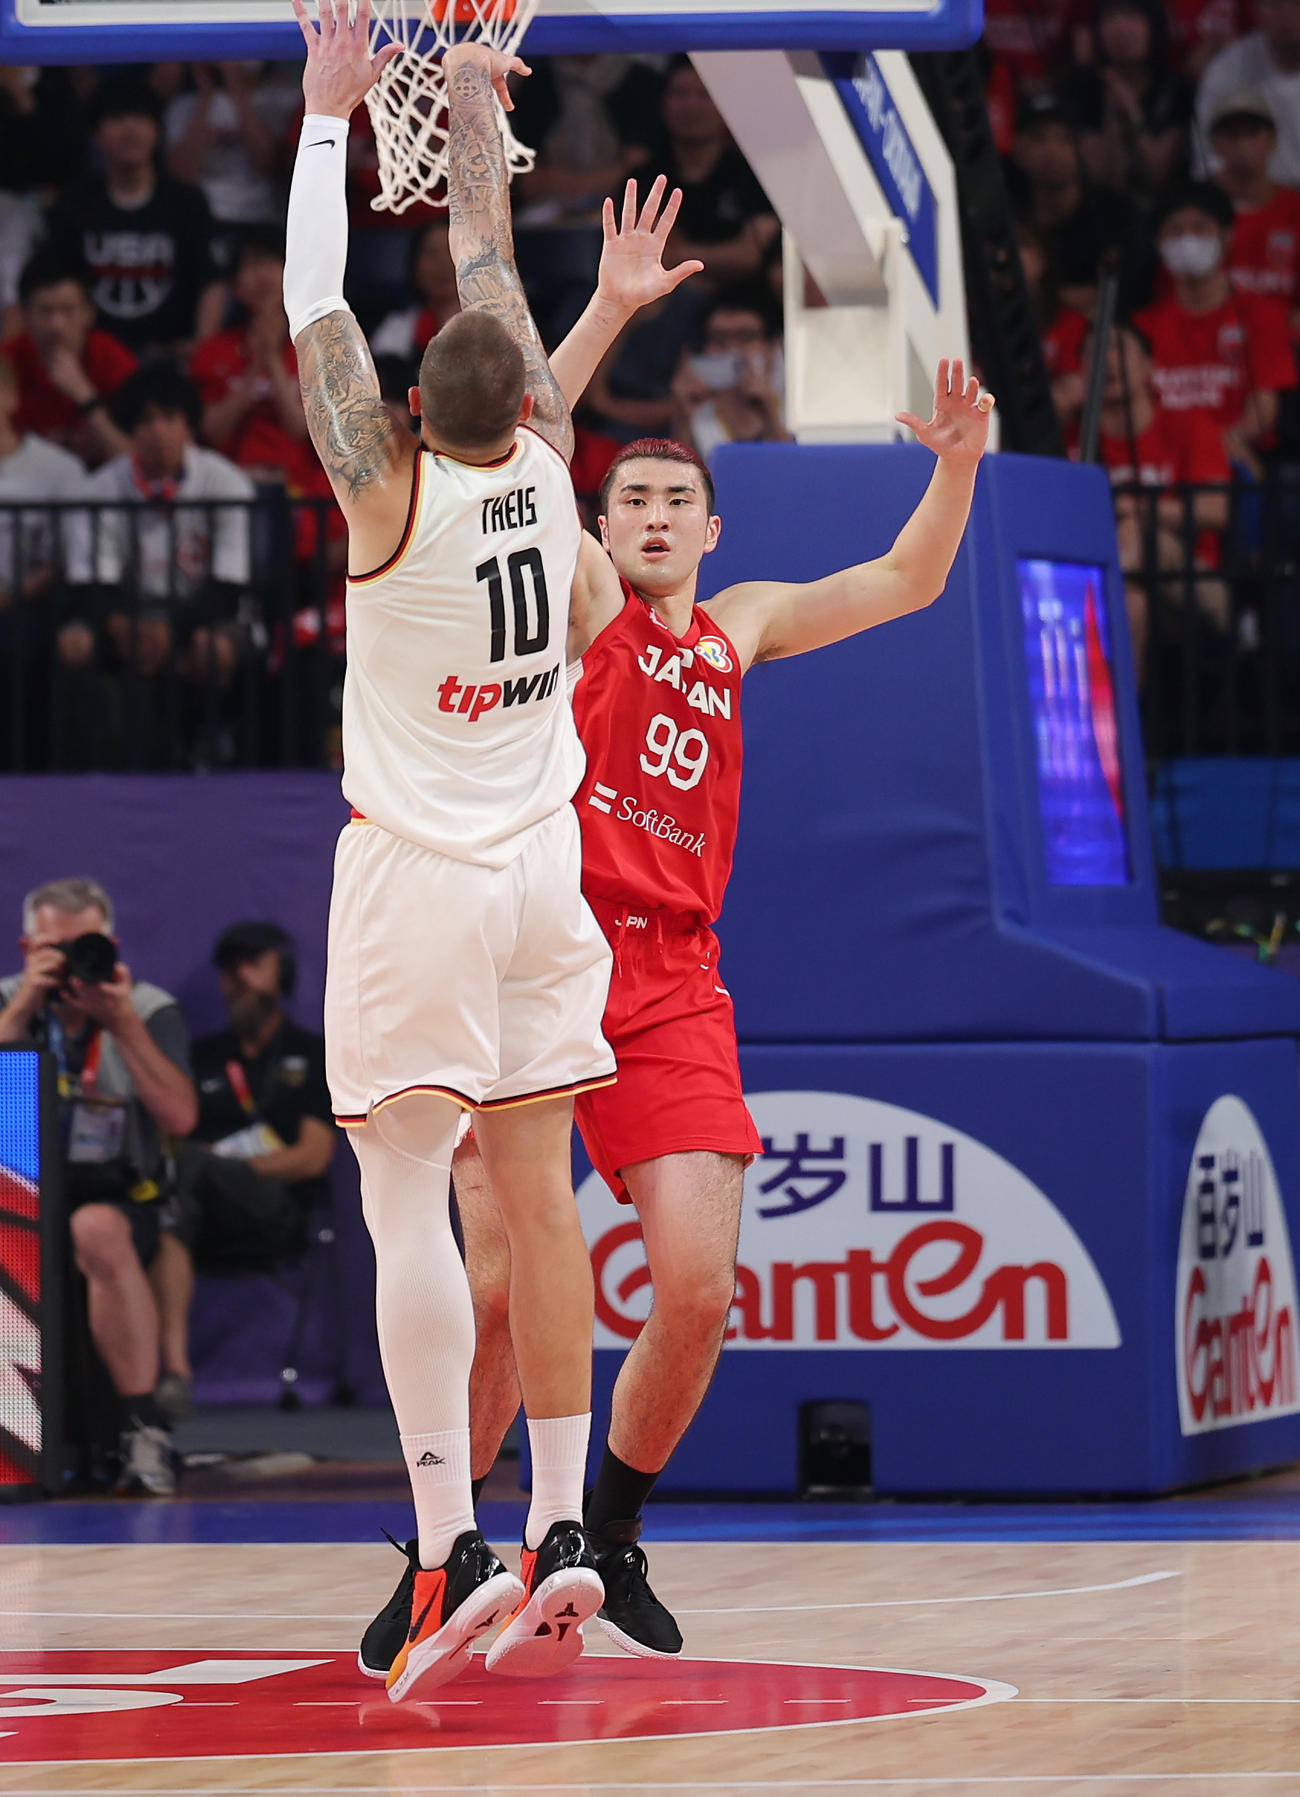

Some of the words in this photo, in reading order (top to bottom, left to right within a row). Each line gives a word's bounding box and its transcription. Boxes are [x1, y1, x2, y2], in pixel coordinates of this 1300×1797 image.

[481, 485, 537, 535] THEIS
[475, 546, 551, 664] 10
[437, 662, 561, 723] tipwin
[638, 644, 732, 721] JAPAN
[639, 713, 710, 791] 99
[616, 795, 707, 858] SoftBank
[756, 1132, 955, 1221] 岁山
[416, 1458, 446, 1467] PEAK
